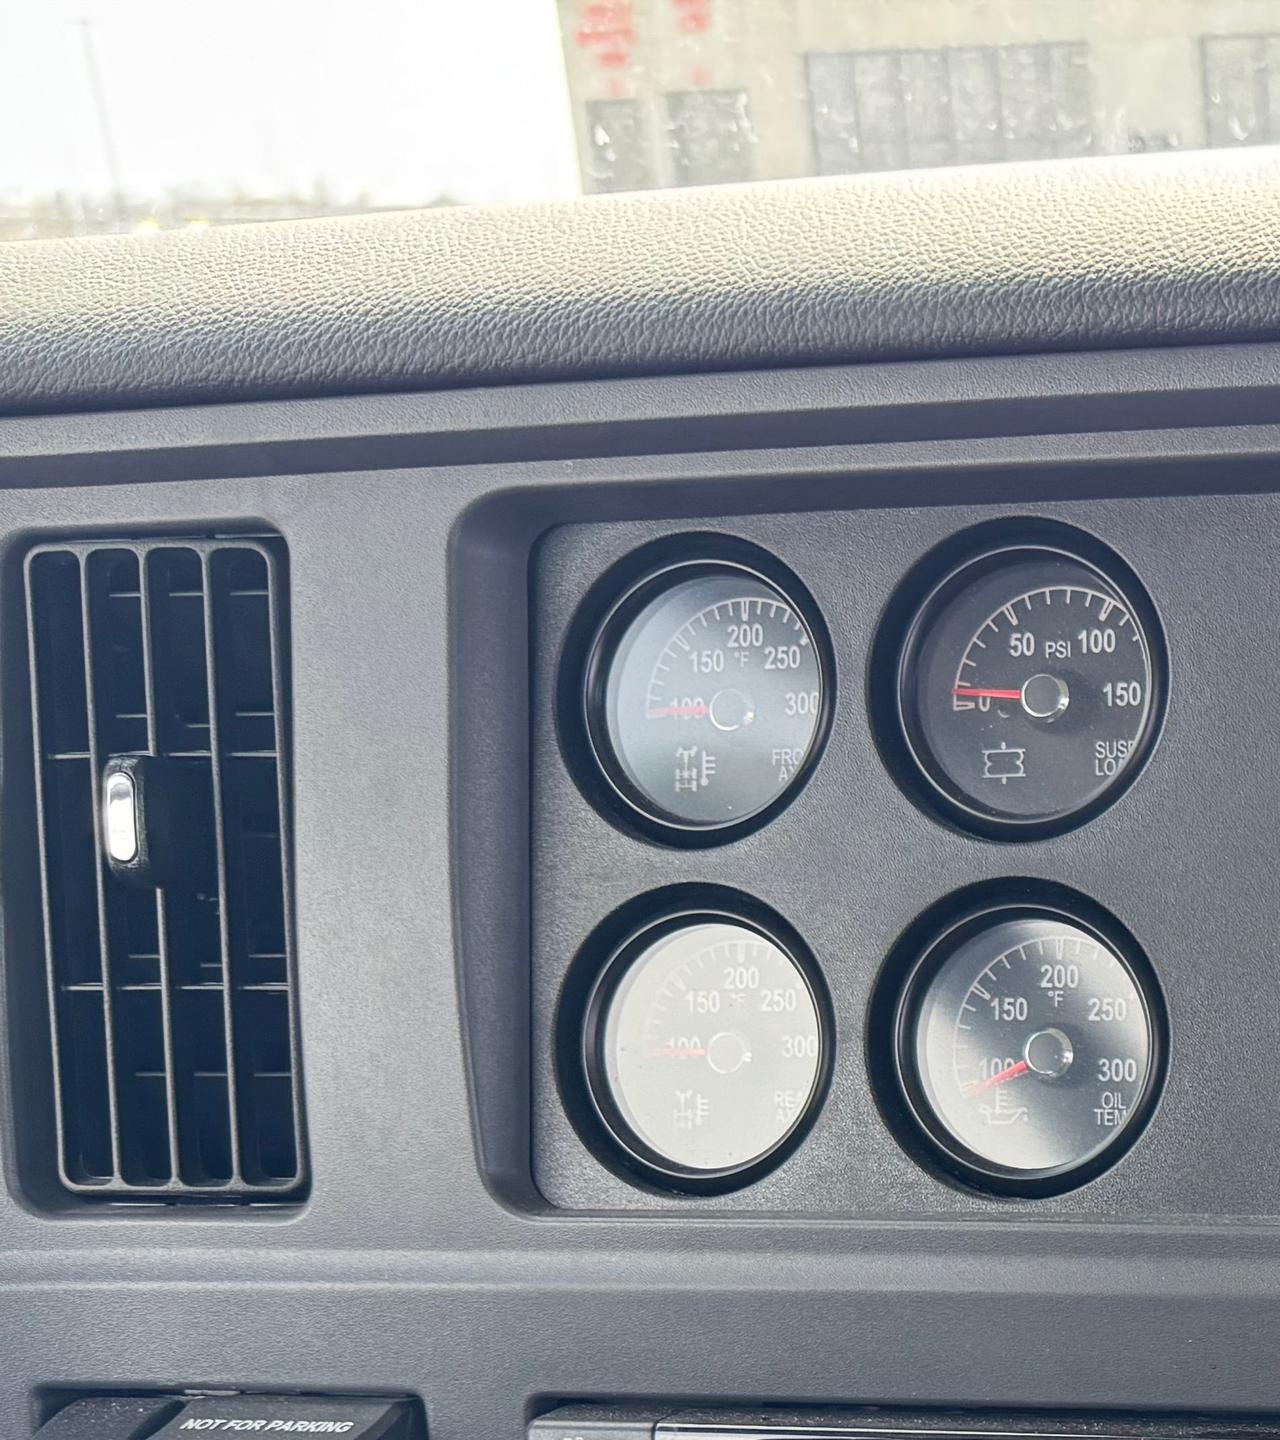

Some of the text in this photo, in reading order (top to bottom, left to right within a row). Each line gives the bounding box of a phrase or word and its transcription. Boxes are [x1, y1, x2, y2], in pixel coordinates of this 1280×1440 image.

[727, 624, 764, 648] 200
[1010, 632, 1034, 656] 50
[1078, 629, 1116, 654] 100
[690, 649, 724, 673] 150
[764, 646, 801, 670] 250
[1045, 641, 1071, 659] PSI
[784, 692, 819, 716] 300
[1102, 682, 1141, 706] 150
[724, 966, 760, 989] 200
[1040, 964, 1079, 988] 200
[685, 990, 720, 1013] 150
[760, 989, 797, 1012] 250
[990, 997, 1028, 1021] 150
[1088, 998, 1126, 1021] 250
[781, 1035, 818, 1058] 300
[1098, 1059, 1137, 1082] 300
[1102, 1092, 1126, 1108] OIL
[180, 1418, 354, 1433] NOT FOR PARKING
